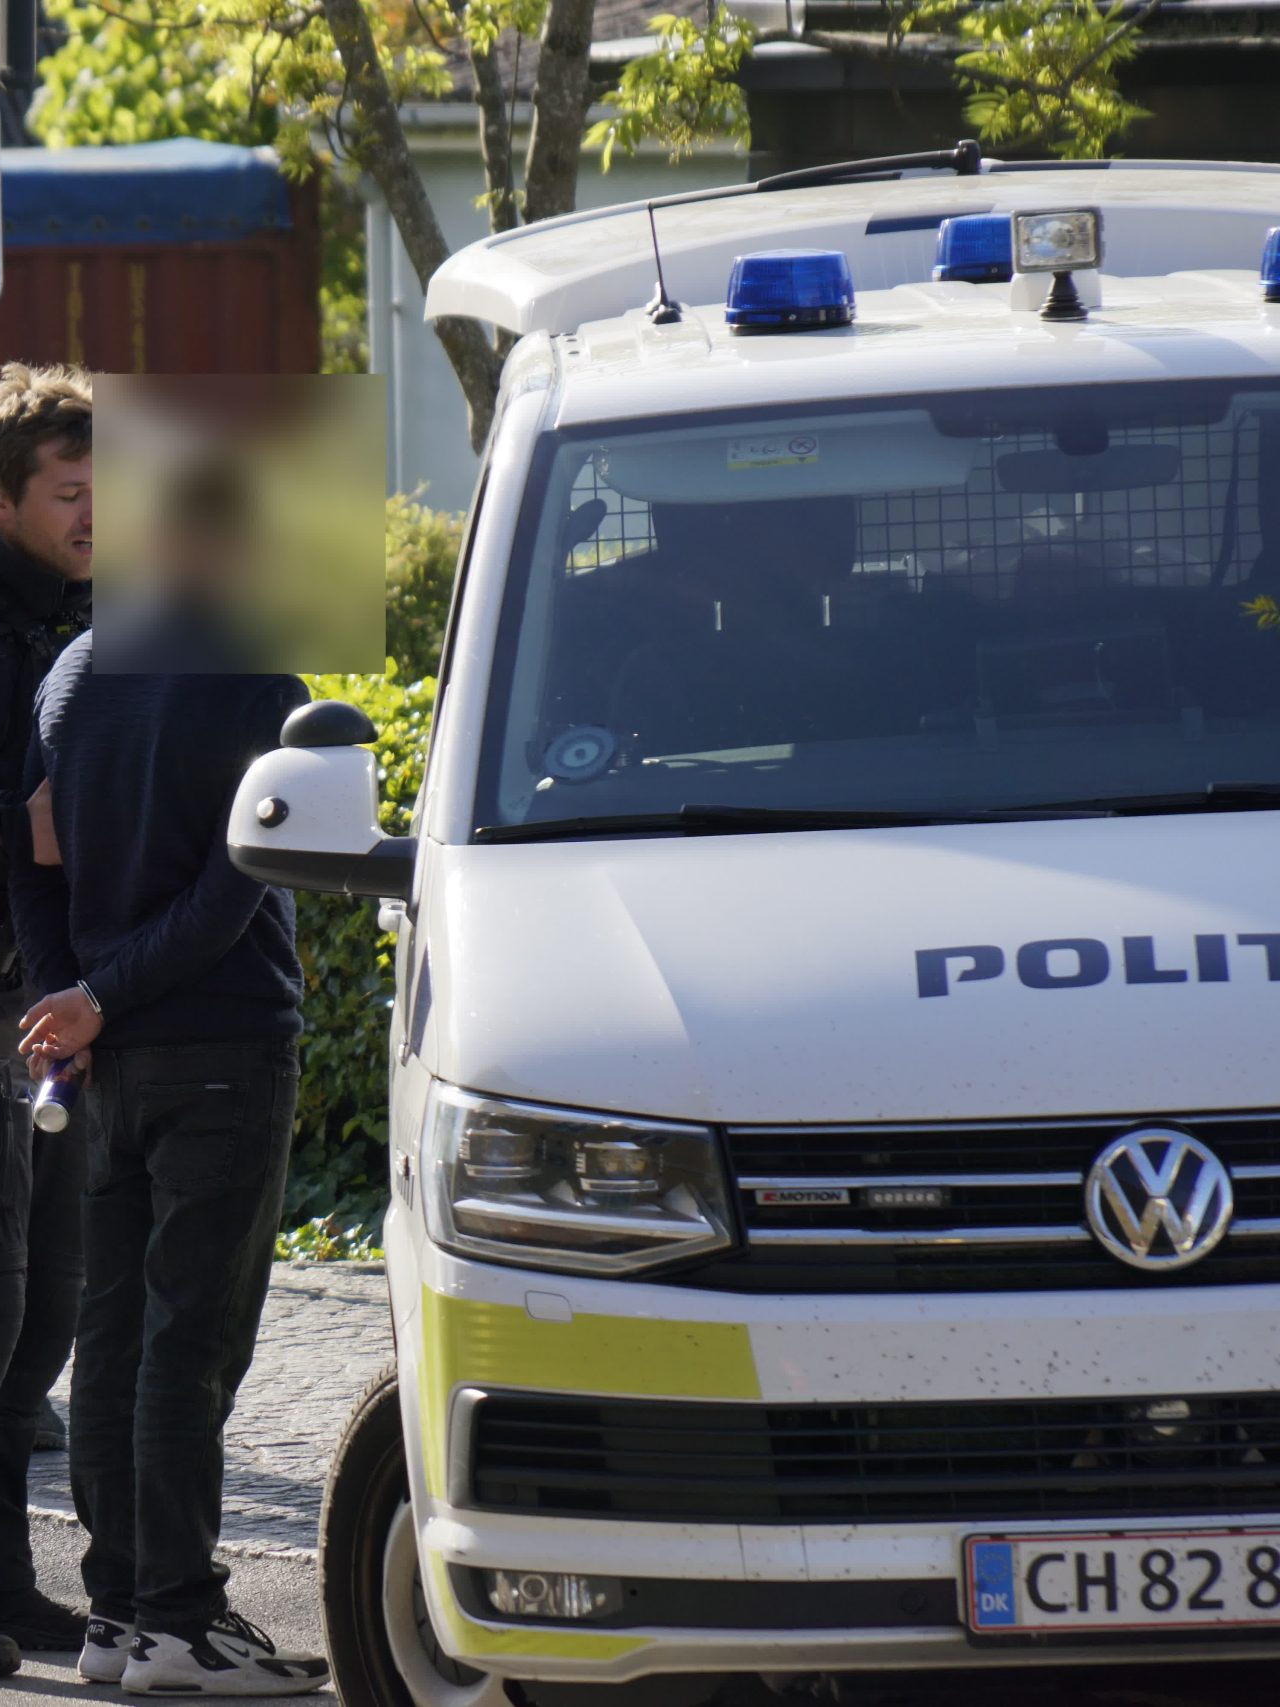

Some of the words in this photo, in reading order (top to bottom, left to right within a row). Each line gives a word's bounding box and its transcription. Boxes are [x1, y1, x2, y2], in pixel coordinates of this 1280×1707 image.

[1026, 1551, 1118, 1613] CH
[1139, 1548, 1225, 1613] 82
[1246, 1545, 1280, 1610] 8
[980, 1592, 1010, 1613] DK
